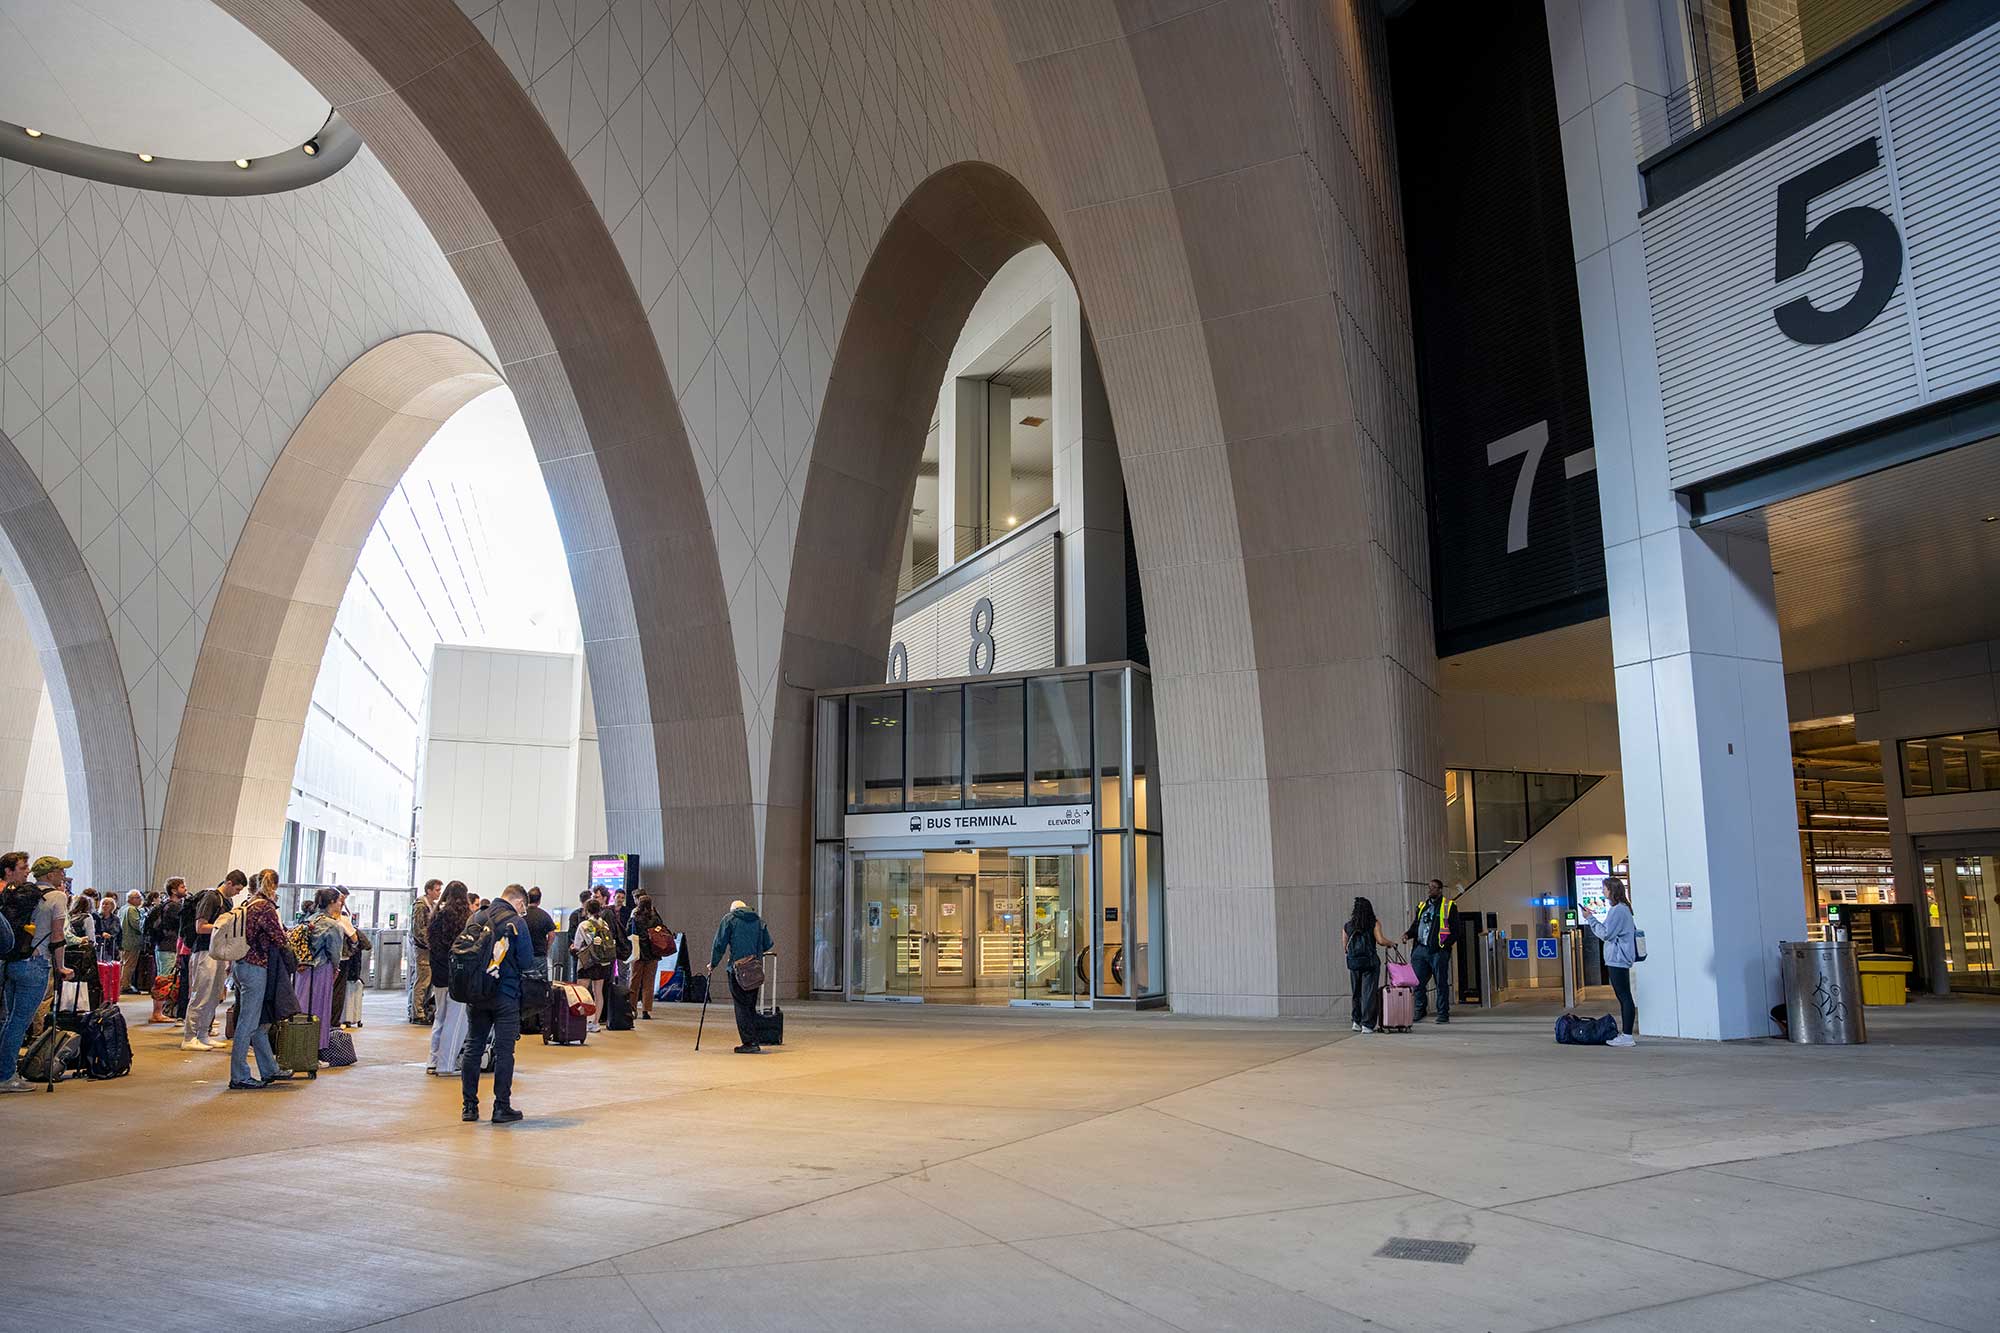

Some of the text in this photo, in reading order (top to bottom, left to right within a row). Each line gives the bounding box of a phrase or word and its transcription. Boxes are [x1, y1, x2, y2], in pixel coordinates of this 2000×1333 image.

[1774, 136, 1903, 345] 5
[969, 597, 995, 675] 8
[927, 815, 1017, 829] BUS TERMINAL
[1047, 818, 1081, 826] ELEVATOR
